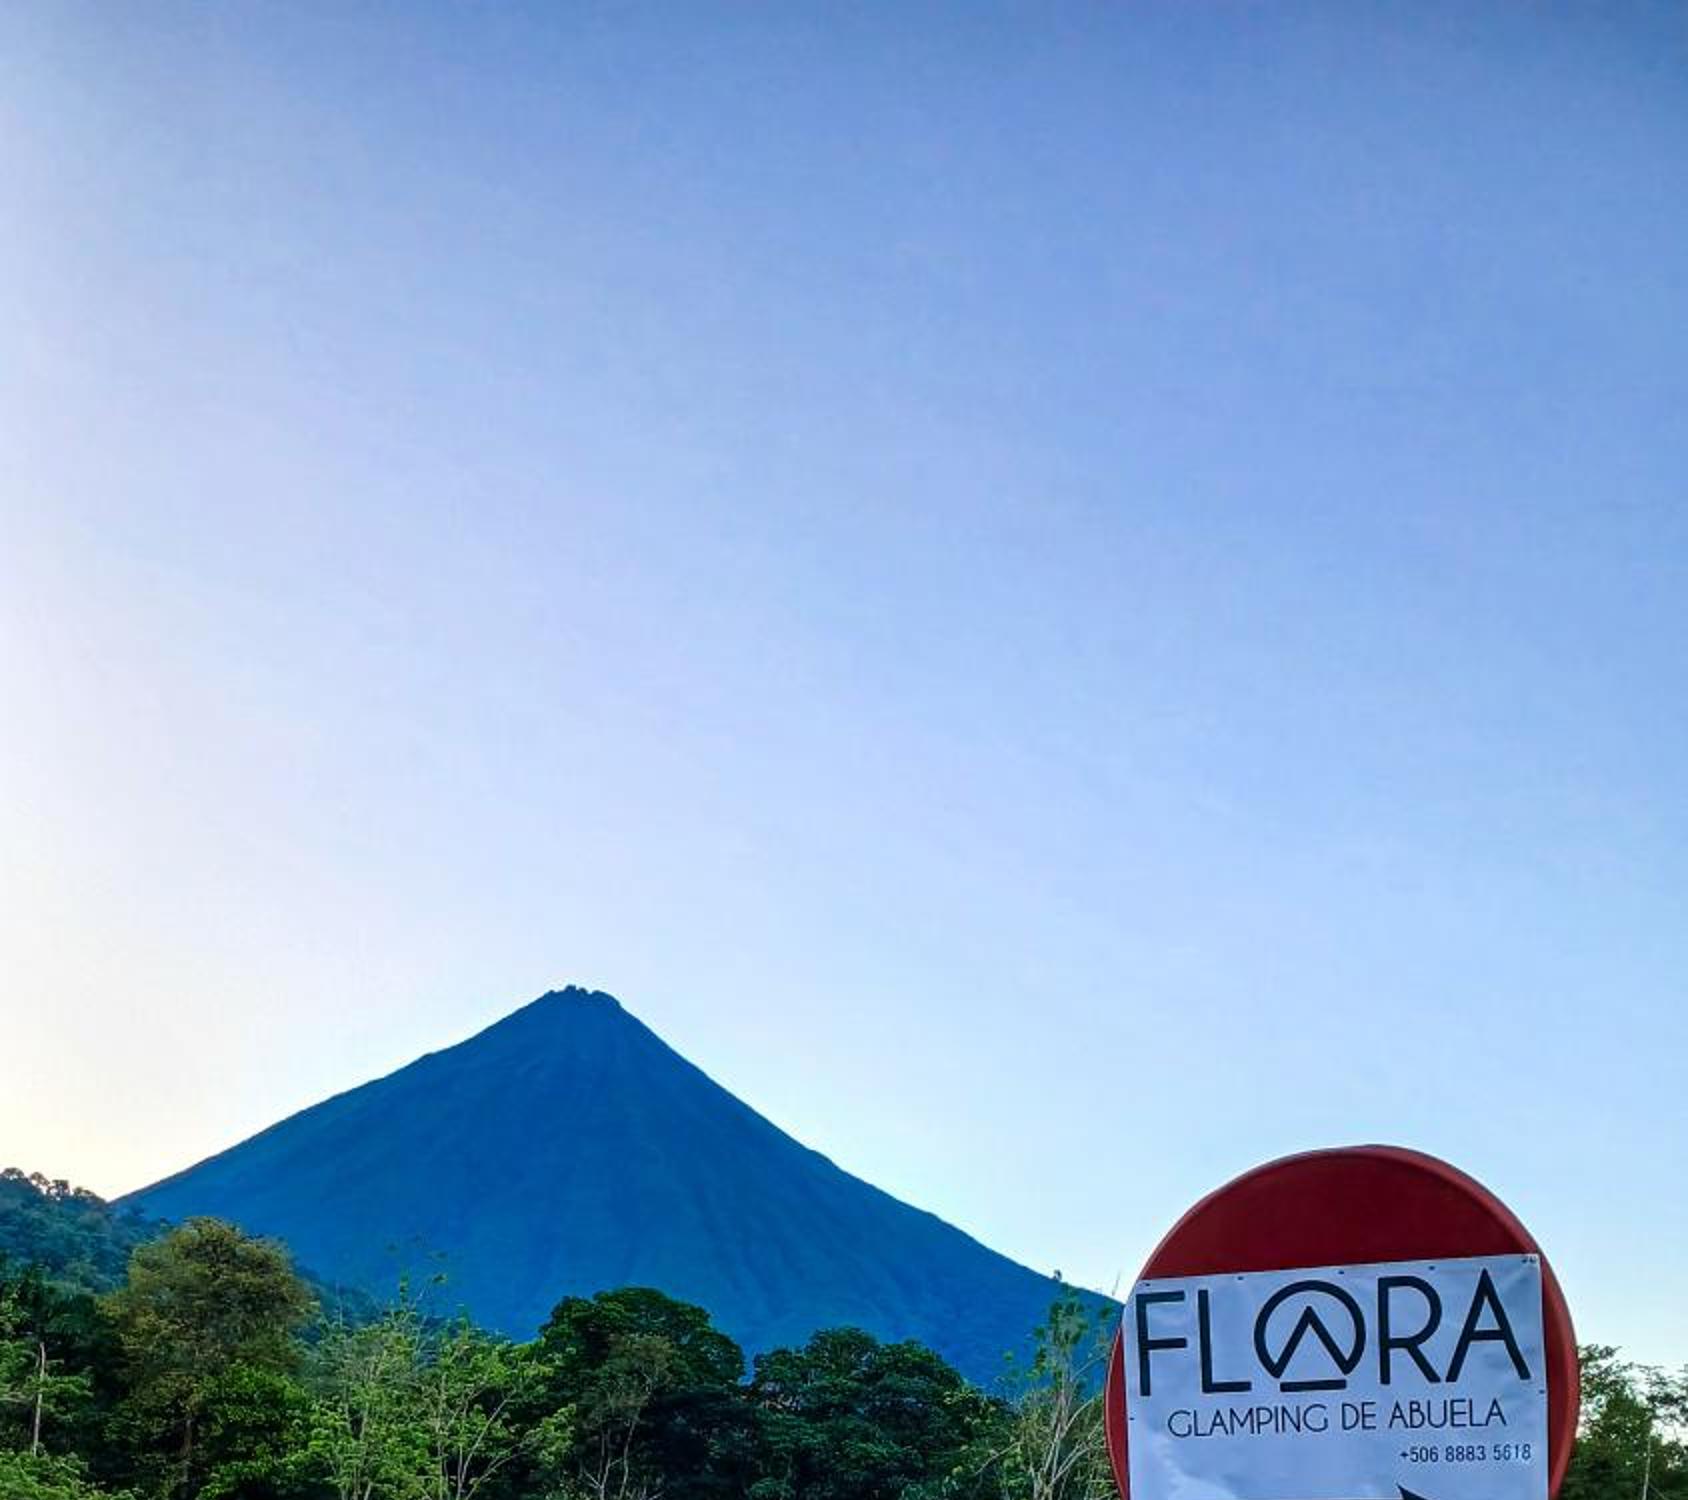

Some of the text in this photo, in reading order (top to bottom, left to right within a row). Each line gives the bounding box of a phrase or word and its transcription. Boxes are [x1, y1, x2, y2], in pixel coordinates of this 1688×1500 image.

[1167, 1398, 1507, 1438] GLAMPING DE ABUELA
[1400, 1443, 1532, 1463] +506 8883 5618
